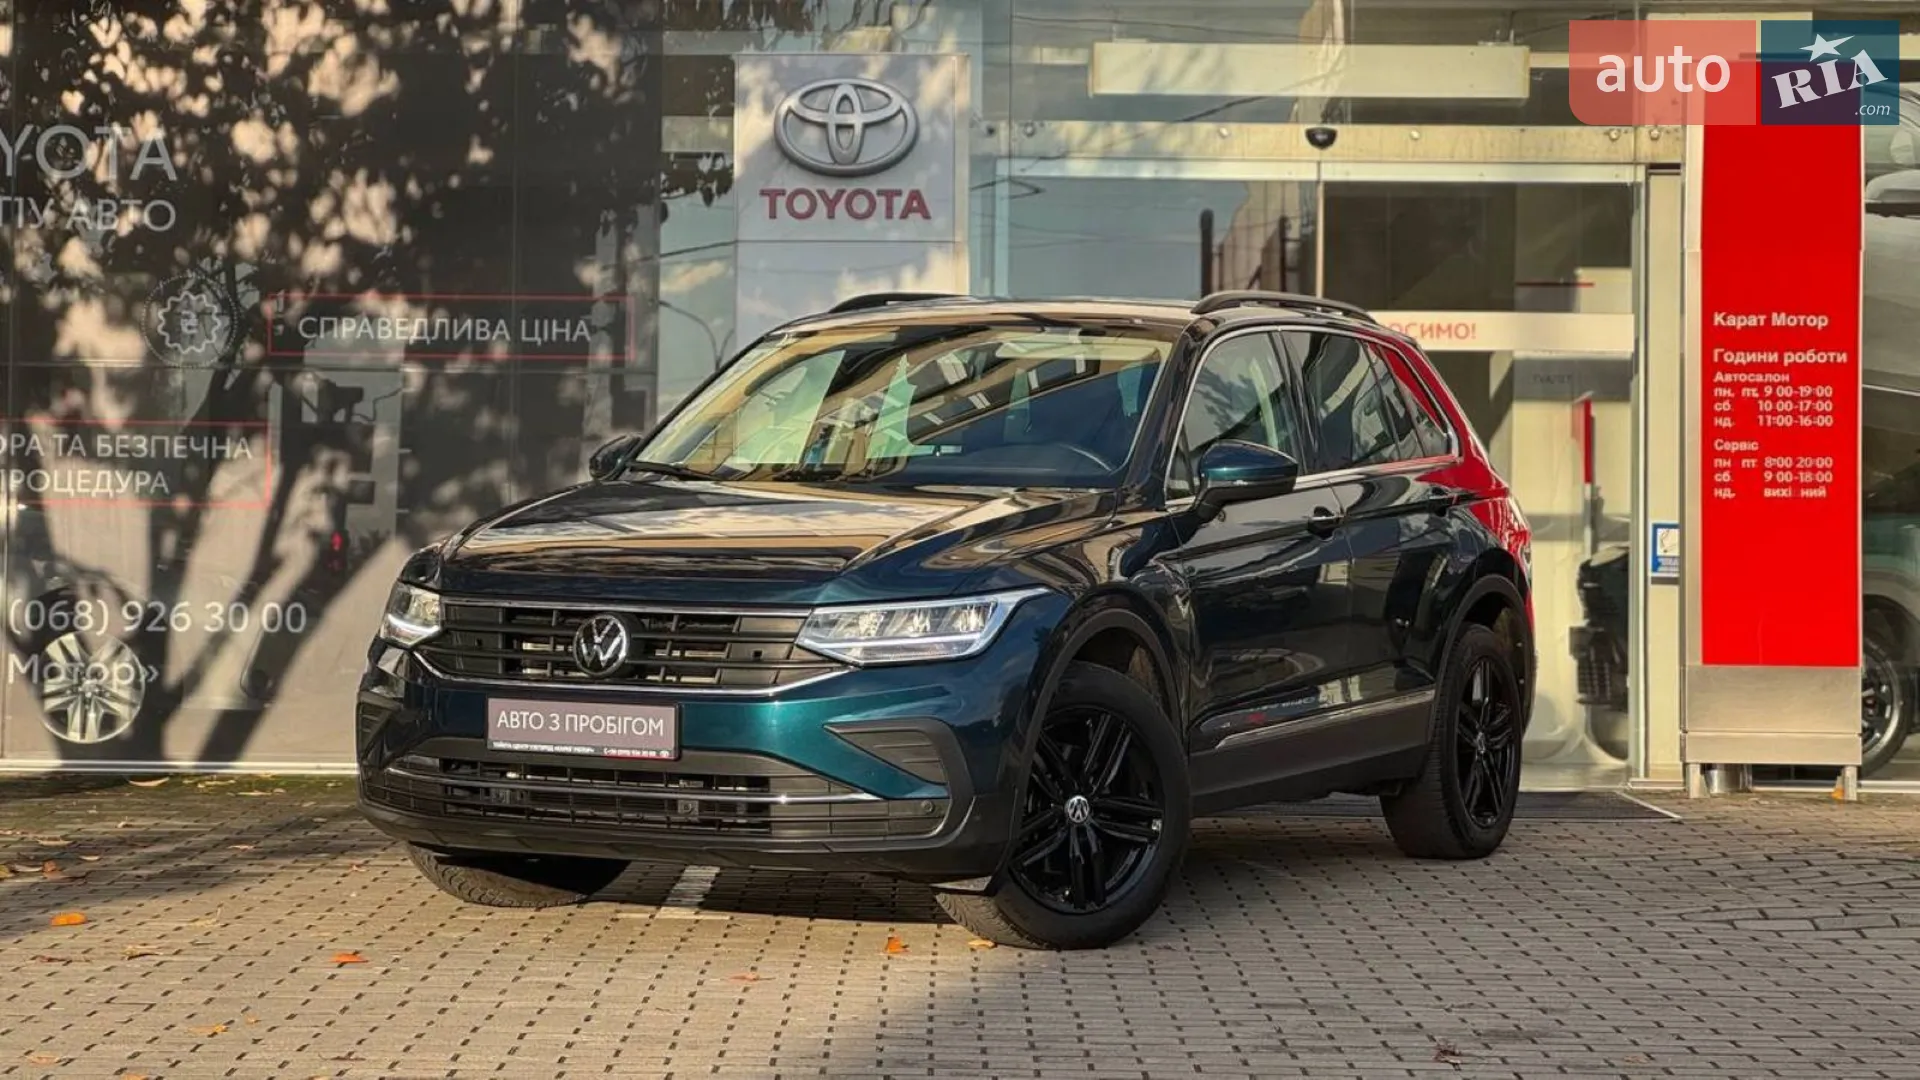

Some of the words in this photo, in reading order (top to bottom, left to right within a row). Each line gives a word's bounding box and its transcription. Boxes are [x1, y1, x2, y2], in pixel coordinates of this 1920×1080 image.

[65, 197, 177, 232] АВТО
[759, 187, 932, 220] TOYOTA
[299, 316, 512, 345] СПРАВЕДЛИВА
[520, 318, 592, 346] ЦІНА
[1713, 311, 1767, 330] Карат
[1771, 311, 1829, 330] Мотор
[1713, 347, 1779, 366] Години
[1783, 348, 1848, 367] роботи
[1713, 371, 1790, 383] Автосалон
[52, 433, 87, 458] ТА
[96, 434, 254, 460] БЕЗПЕЧНА
[9, 598, 109, 636] (068)
[121, 600, 192, 633] 926
[204, 601, 249, 633] 30
[261, 602, 307, 634] 00
[7, 653, 160, 686] Мотор»
[497, 710, 545, 731] АВТО
[549, 713, 561, 732] З
[565, 713, 664, 737] ПРОБІГОМ
